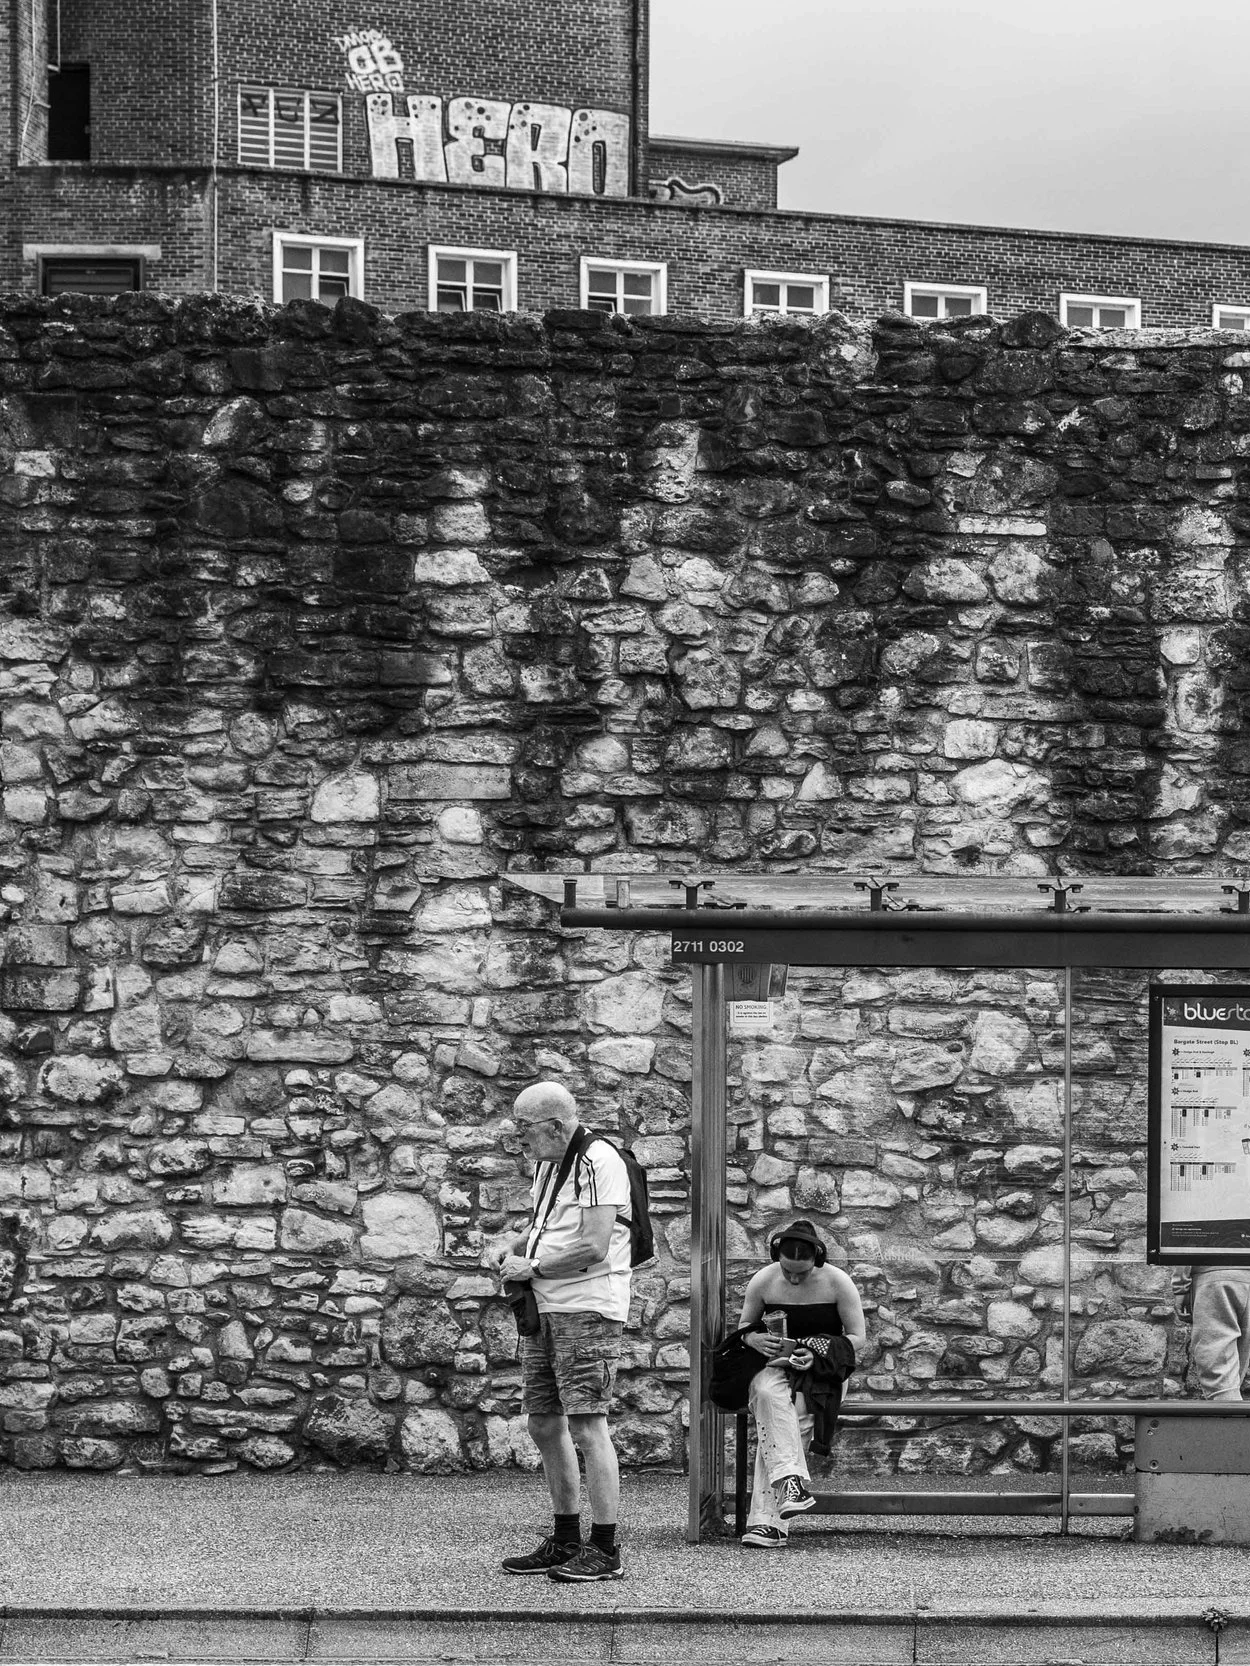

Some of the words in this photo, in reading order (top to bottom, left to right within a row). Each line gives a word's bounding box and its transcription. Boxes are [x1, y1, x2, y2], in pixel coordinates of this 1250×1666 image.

[344, 72, 404, 92] HERO
[364, 92, 630, 198] HERO
[673, 940, 703, 953] 2711
[709, 940, 745, 953] 0302
